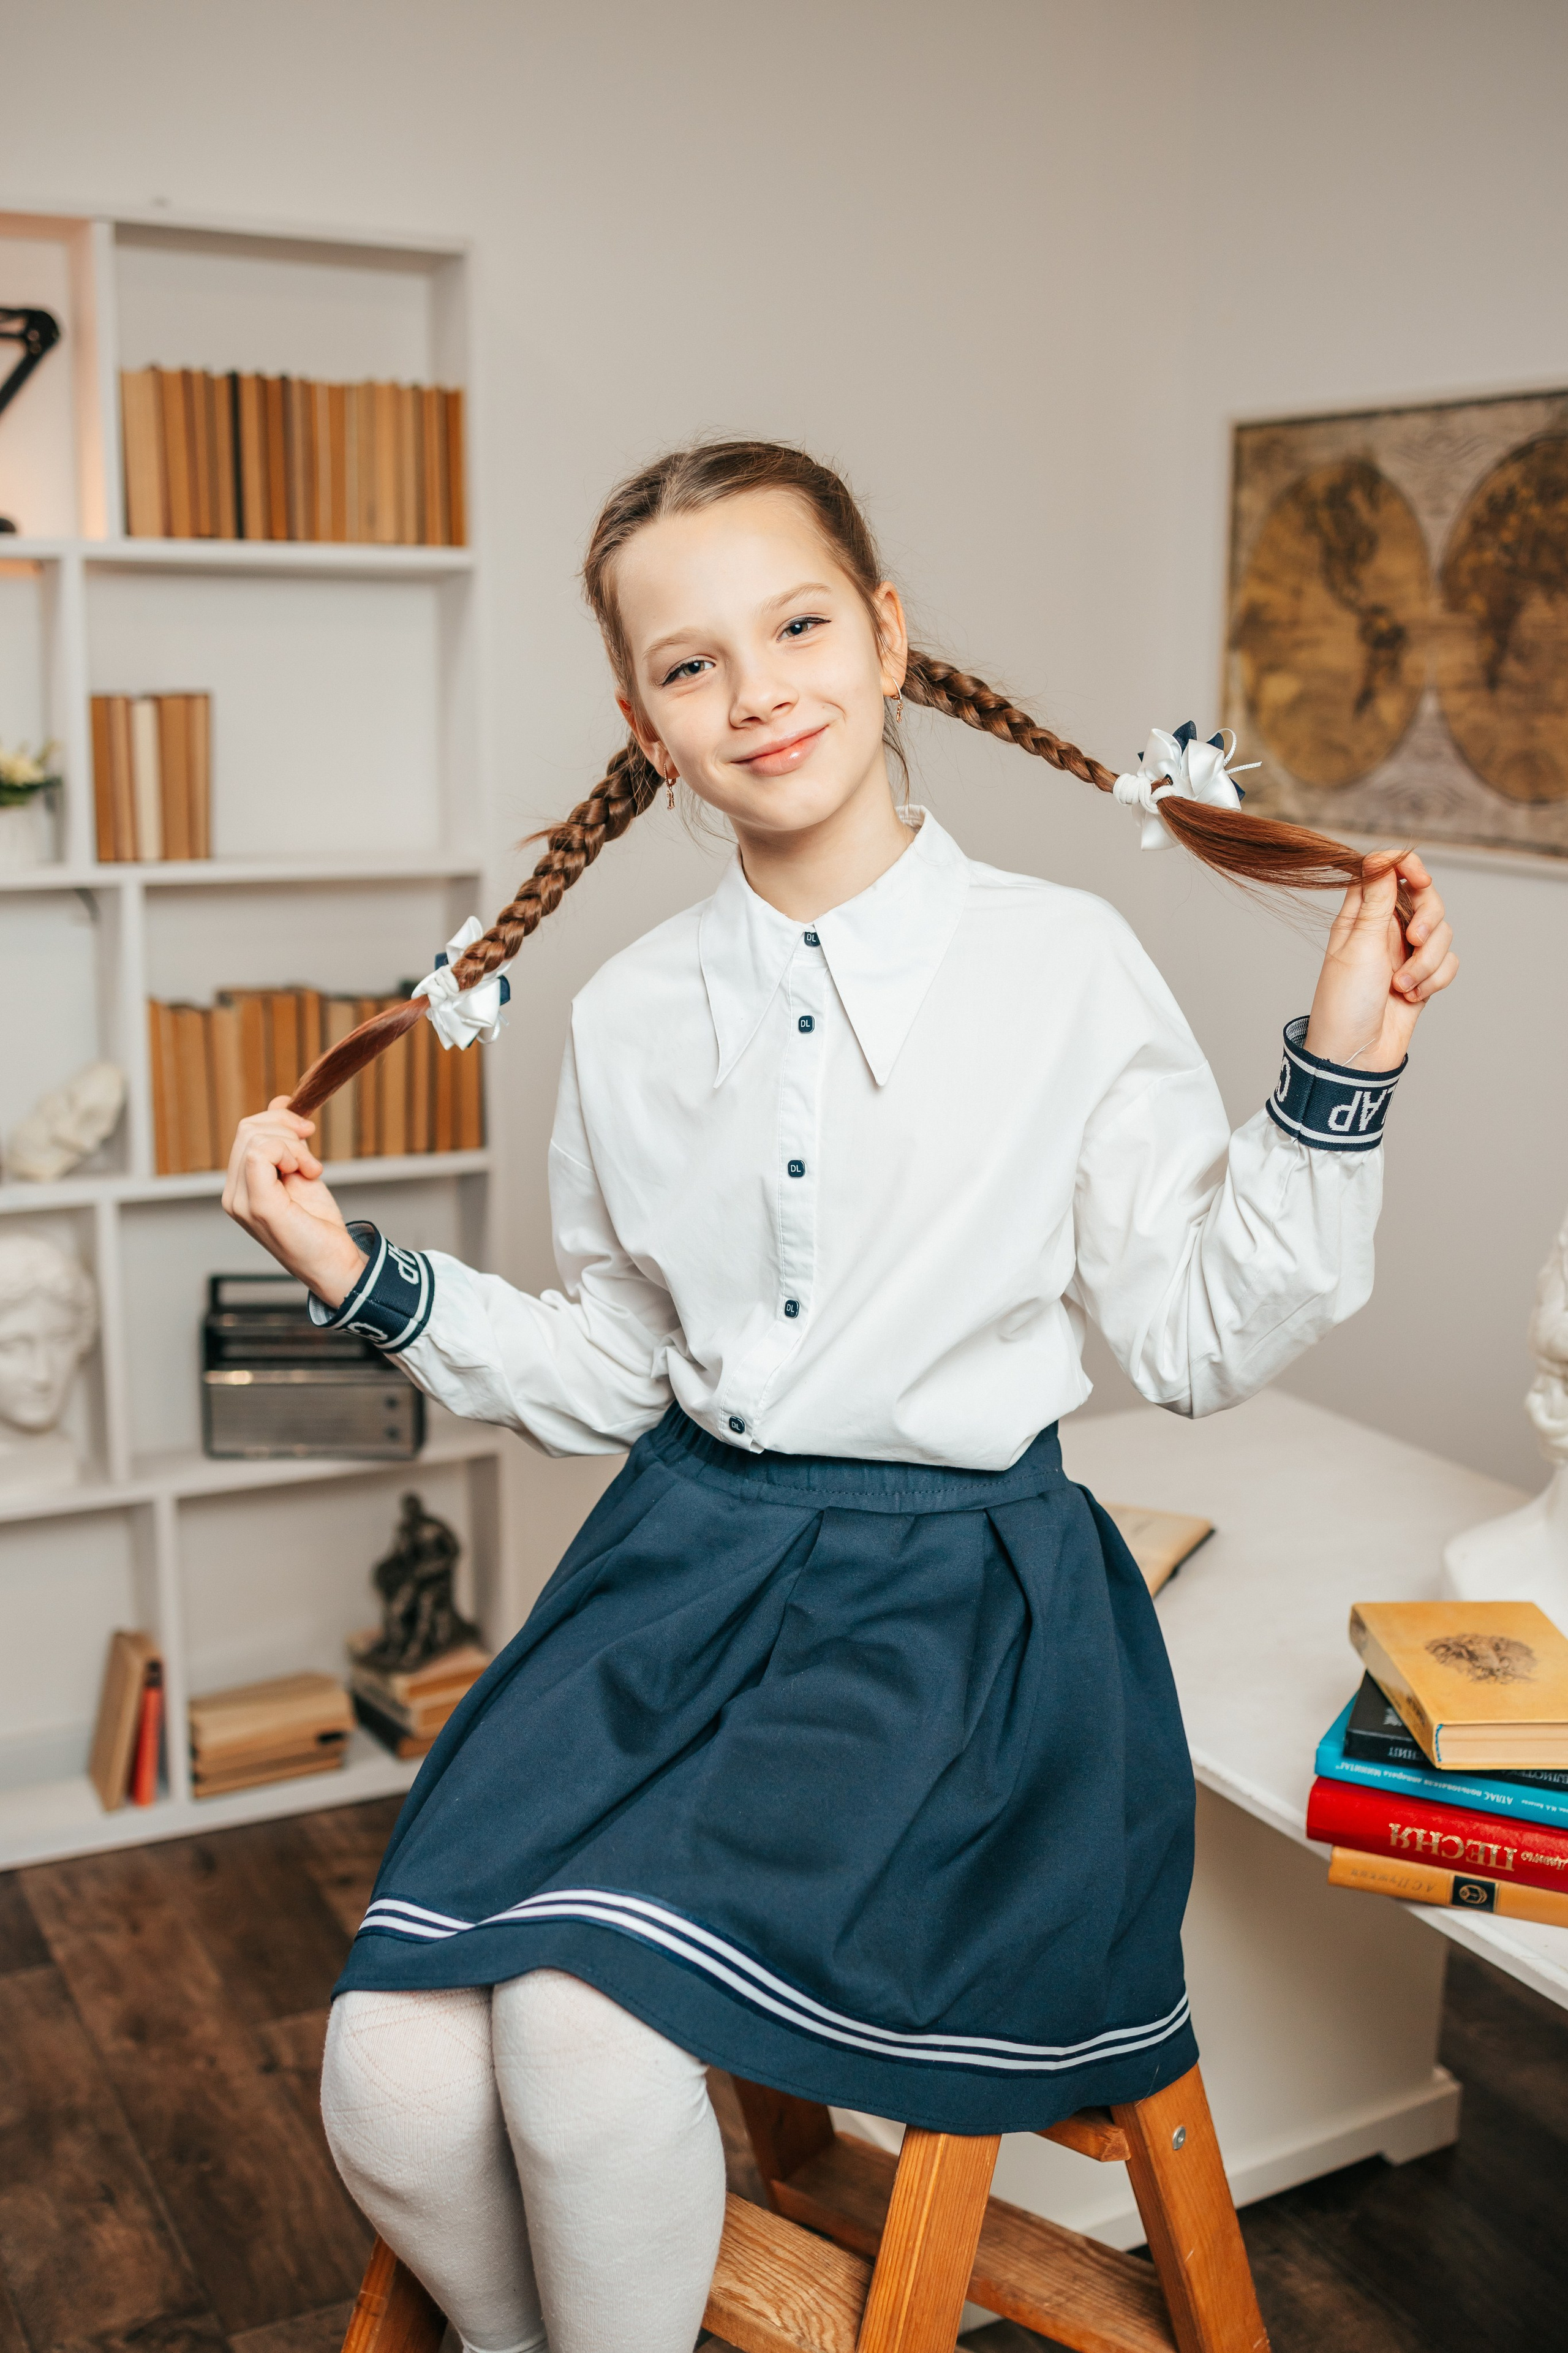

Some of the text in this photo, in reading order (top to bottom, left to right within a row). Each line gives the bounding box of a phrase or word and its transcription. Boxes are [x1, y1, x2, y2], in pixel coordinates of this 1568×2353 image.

[807, 933, 816, 942] DL
[786, 1304, 795, 1313] DL
[731, 1421, 741, 1431] DL
[1484, 1791, 1514, 1805] АТЛАС
[1388, 1822, 1518, 1872] ПЕСНЯ
